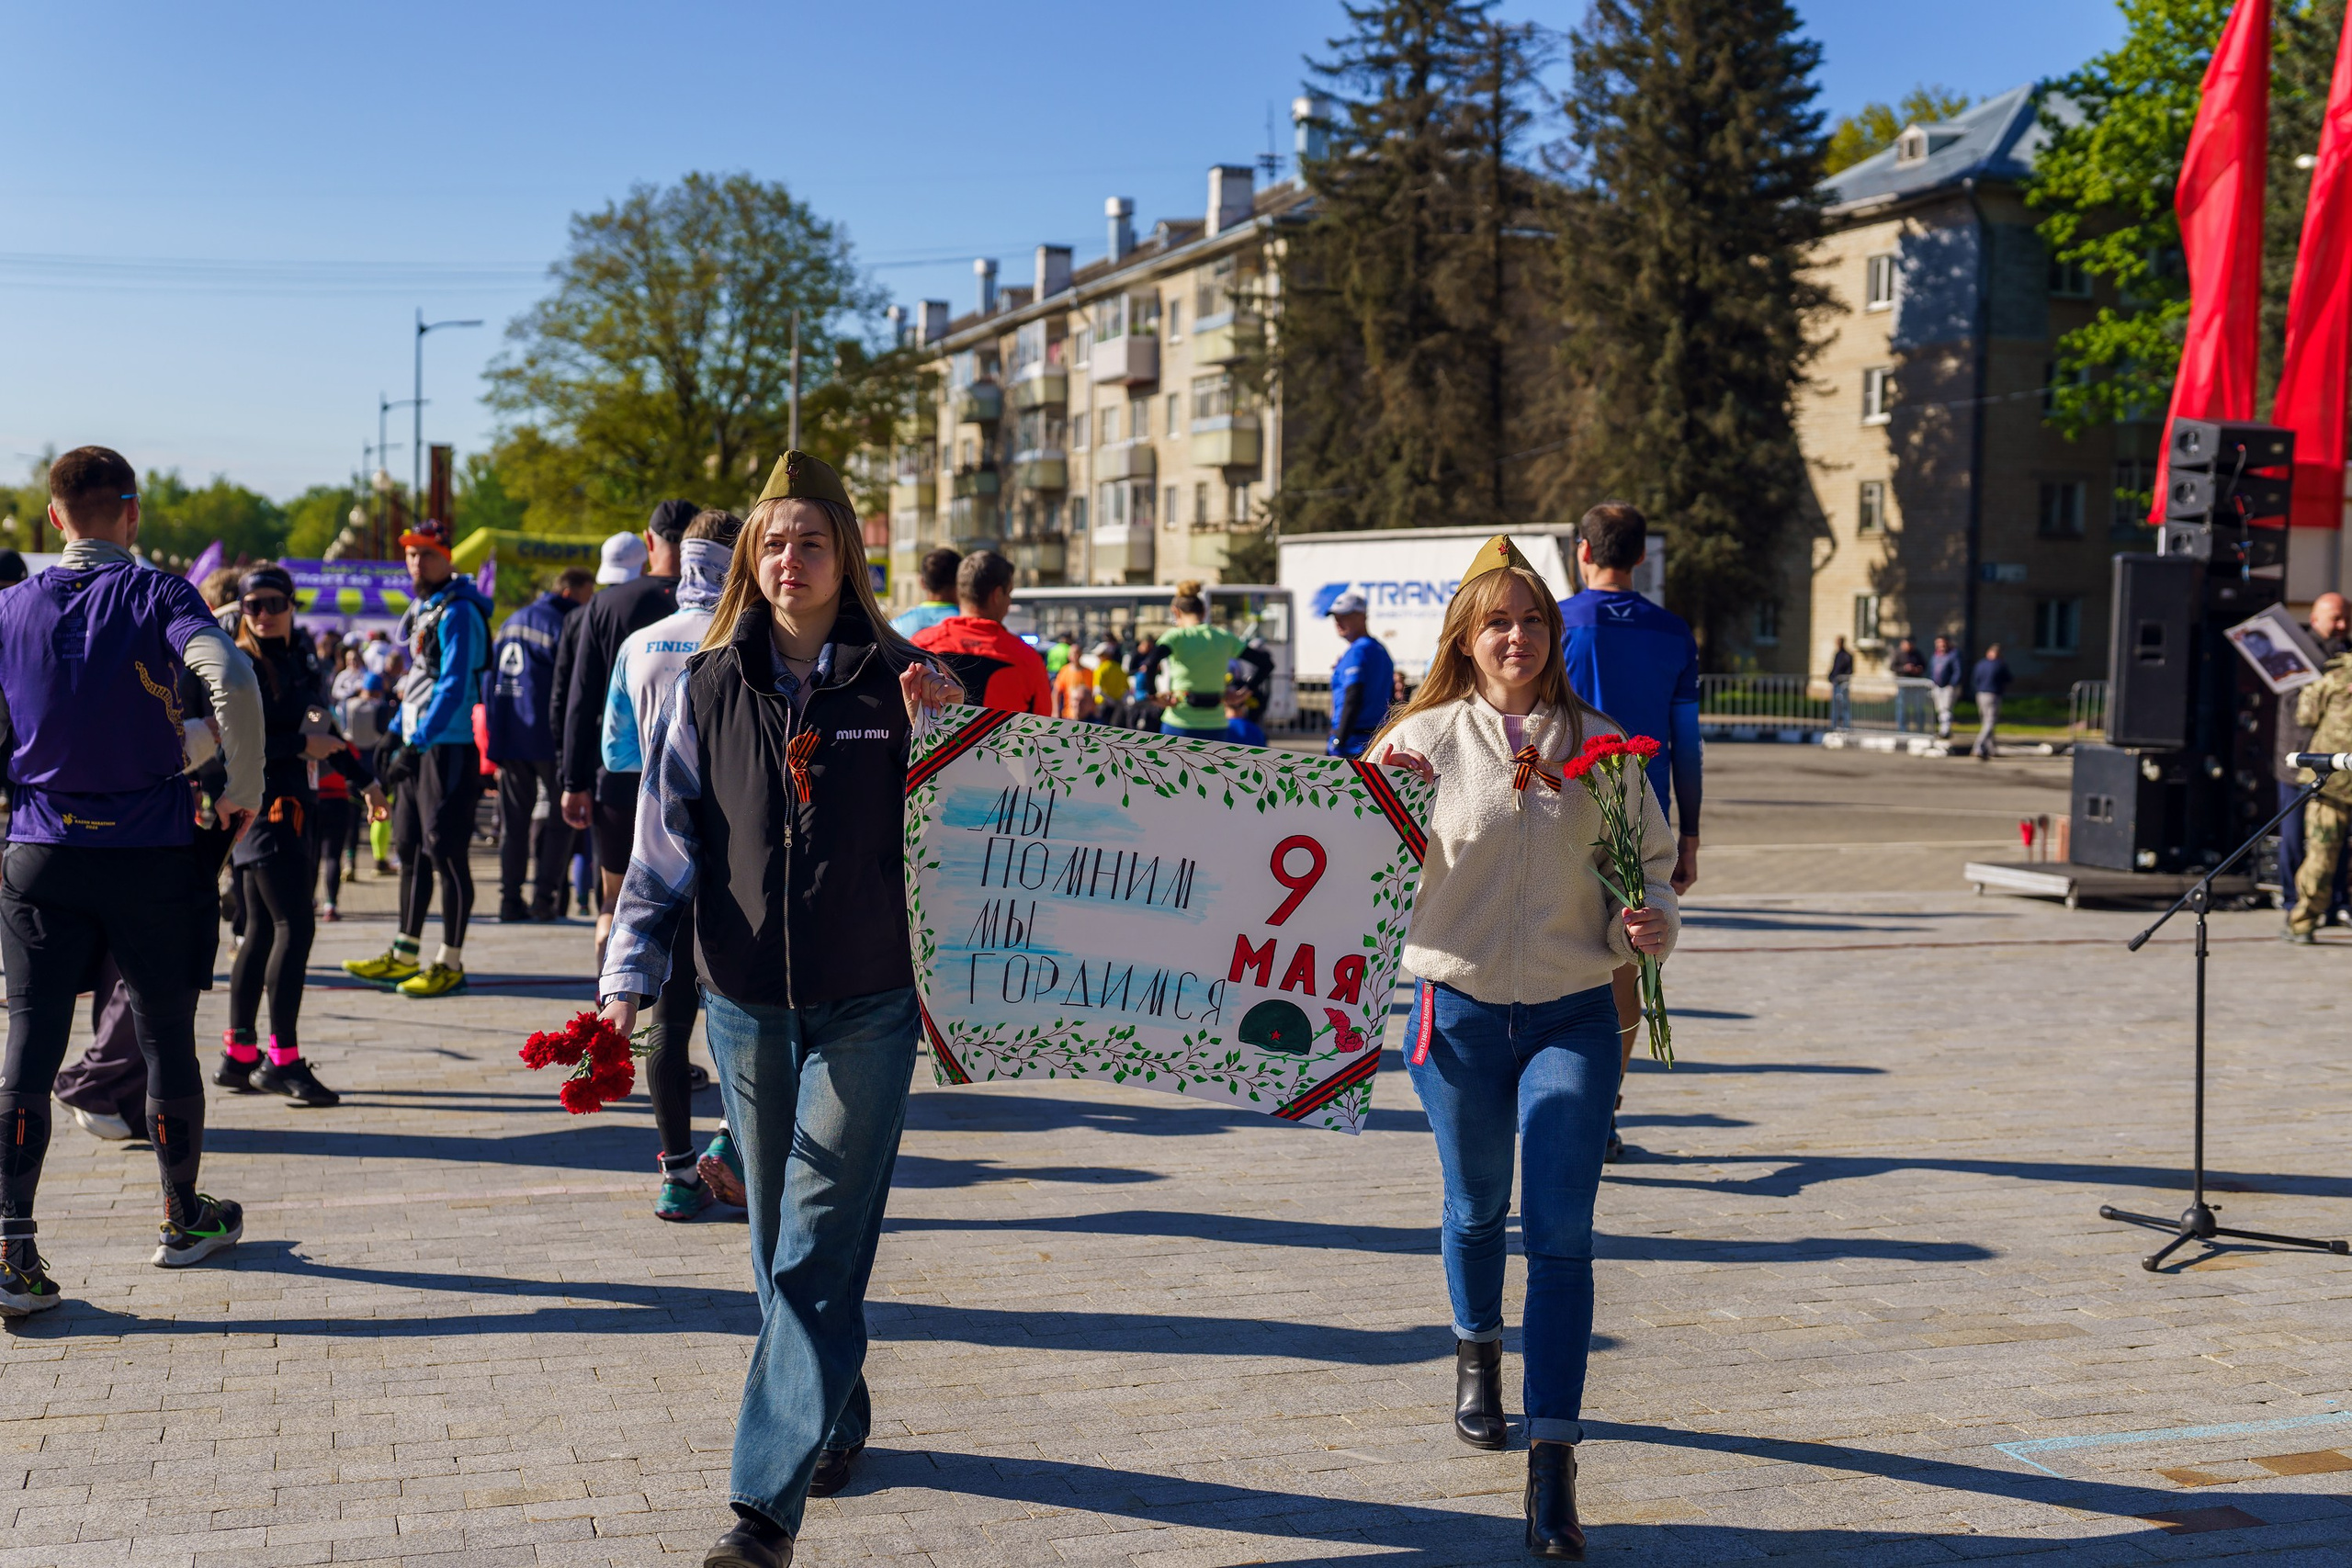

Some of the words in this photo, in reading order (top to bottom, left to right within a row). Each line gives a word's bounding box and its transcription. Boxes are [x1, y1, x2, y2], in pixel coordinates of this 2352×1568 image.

[517, 540, 593, 559] СПОРТ
[967, 785, 1056, 839] МЫ
[980, 837, 1195, 909] ПОМНИМ
[1265, 835, 1327, 926] 9
[966, 898, 1036, 949] МЫ
[970, 953, 1226, 1025] ГОРДИМСЯ
[1227, 933, 1366, 1005] МАЯ
[1420, 1021, 1430, 1043] BEFORE
[1422, 998, 1430, 1021] REMOVE
[1416, 1042, 1426, 1062] FLIGHT
